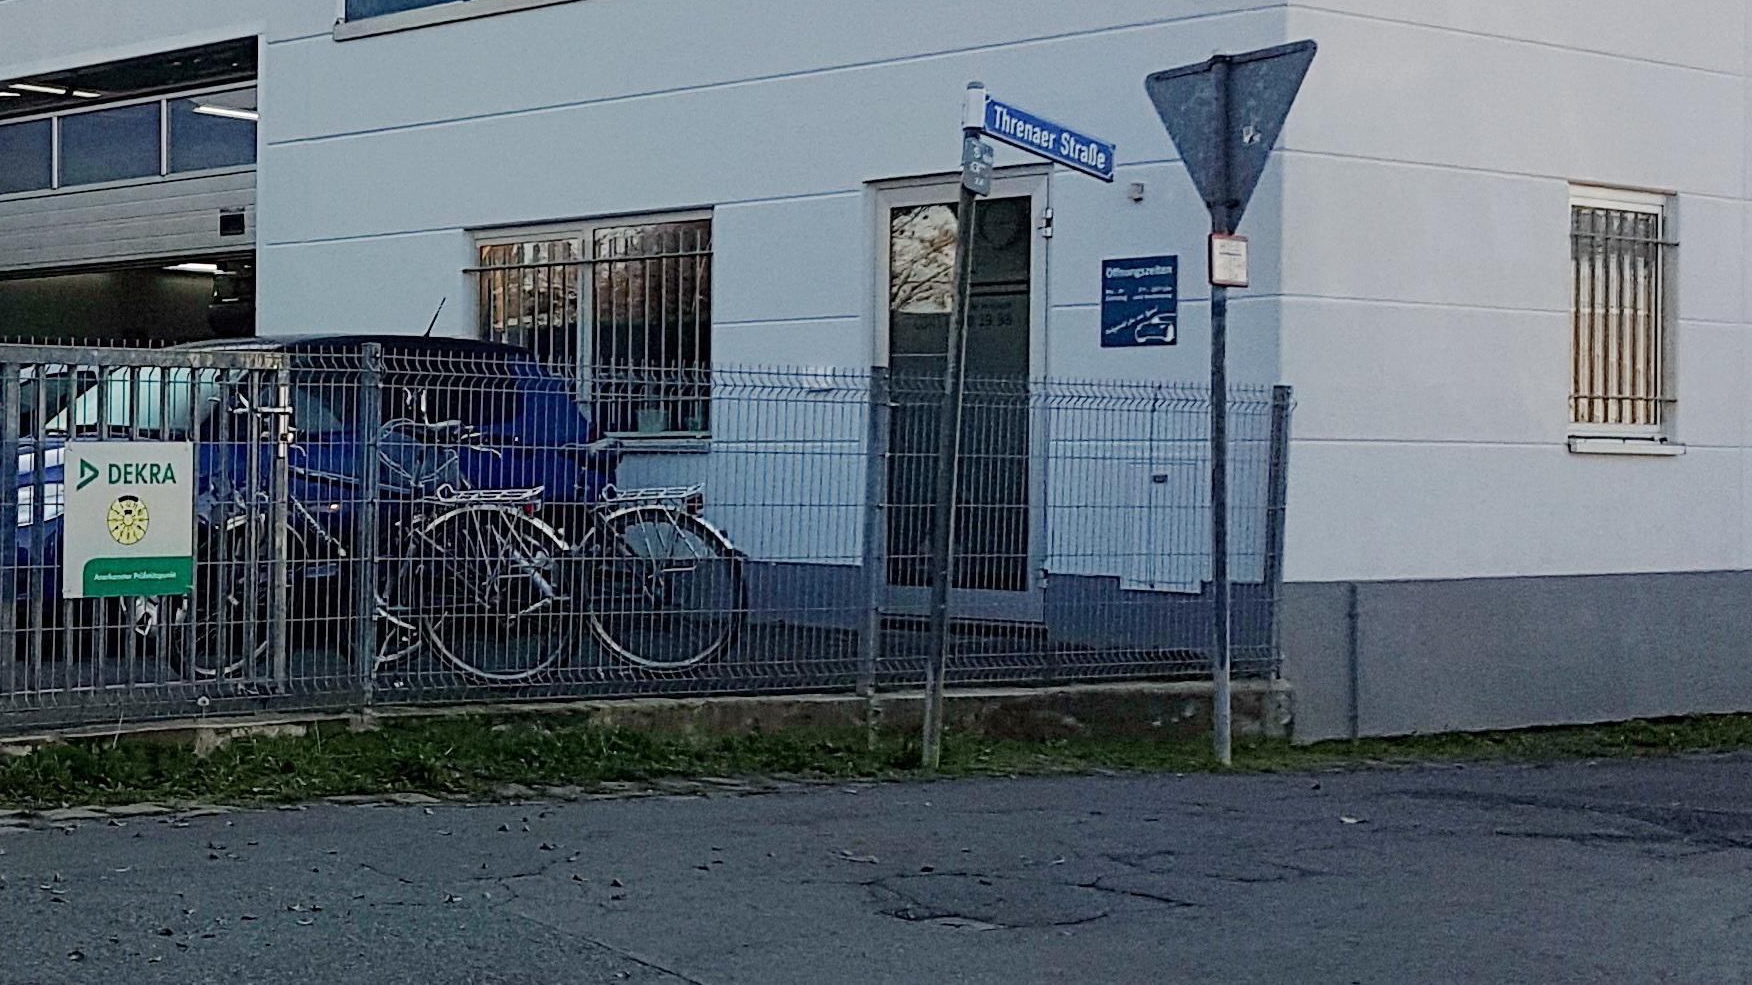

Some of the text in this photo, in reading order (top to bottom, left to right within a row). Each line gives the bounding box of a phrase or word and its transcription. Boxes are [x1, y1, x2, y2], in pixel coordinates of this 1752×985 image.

[994, 105, 1106, 169] Threnaer Straße
[108, 463, 176, 485] DEKRA
